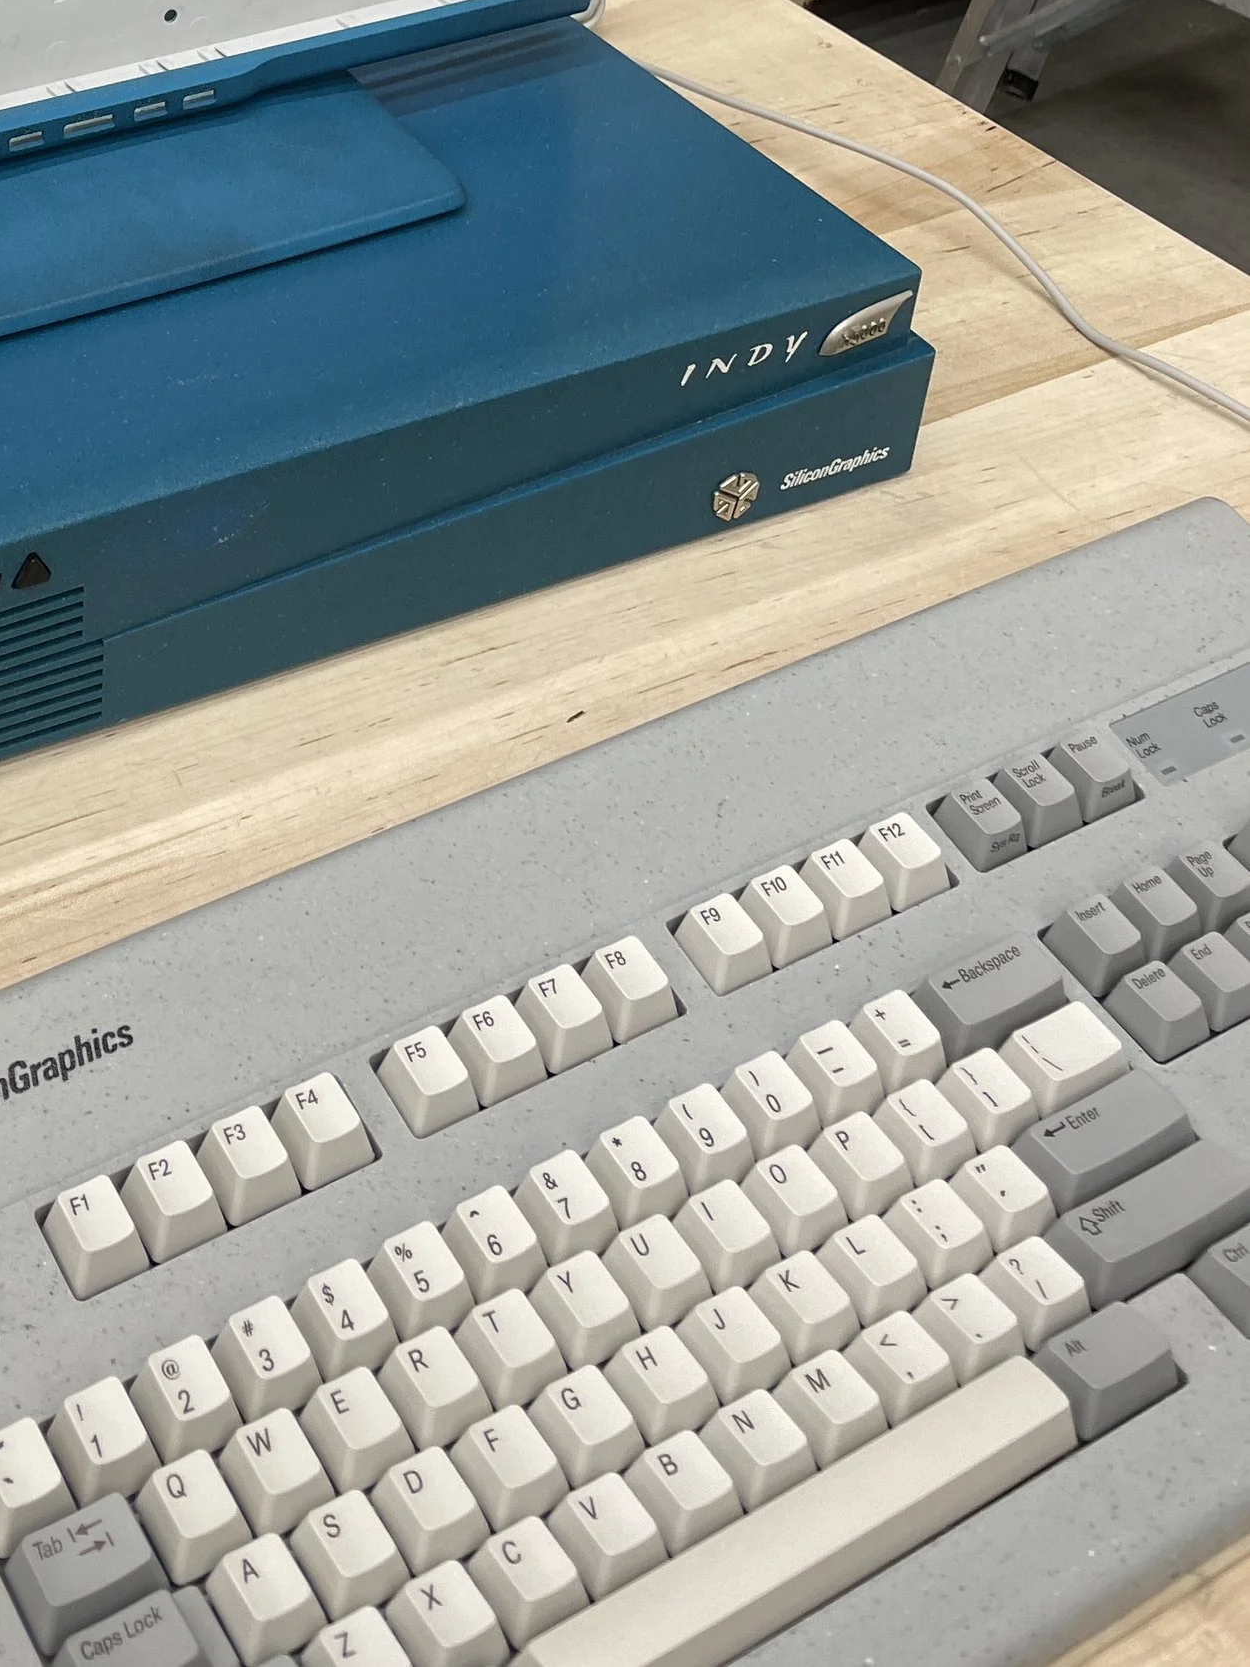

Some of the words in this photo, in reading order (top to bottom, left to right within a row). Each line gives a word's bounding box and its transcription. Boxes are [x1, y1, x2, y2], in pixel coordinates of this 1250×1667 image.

[680, 331, 808, 387] INDY
[780, 446, 890, 491] SiliconGraphics
[1193, 701, 1220, 718] Caps
[1203, 712, 1228, 729] Lock
[1068, 736, 1098, 754] Pause
[1126, 732, 1151, 748] Num
[1135, 742, 1162, 759] Lock
[1012, 760, 1041, 778] Scroll
[1021, 773, 1047, 789] Lock
[959, 789, 982, 806] Print
[969, 796, 1001, 816] Screen
[878, 822, 906, 842] F12
[820, 850, 844, 871] F11
[1186, 850, 1213, 868] Page
[1198, 865, 1215, 879] Up
[760, 875, 788, 897] F10
[1133, 874, 1163, 895] Home
[700, 906, 722, 926] F9
[1074, 901, 1106, 923] Insert
[605, 950, 626, 969] F8
[1190, 943, 1213, 961] End
[957, 944, 1021, 985] Backspace
[538, 979, 558, 998] F7
[1132, 967, 1167, 991] Delete
[473, 1011, 495, 1031] F6
[404, 1041, 427, 1062] F5
[296, 1089, 319, 1110] F4
[765, 1094, 781, 1114] 0
[1066, 1105, 1101, 1130] Enter
[223, 1123, 246, 1144] F3
[699, 1127, 714, 1147] 9
[836, 1130, 850, 1151] P
[148, 1158, 172, 1181] F2
[631, 1161, 647, 1182] 8
[543, 1172, 559, 1190] &
[69, 1194, 90, 1216] F1
[557, 1197, 573, 1219] 7
[1092, 1198, 1126, 1225] Shift
[395, 1242, 413, 1262] %
[486, 1233, 503, 1256] 6
[631, 1235, 650, 1257] U
[844, 1236, 866, 1255] L
[1223, 1242, 1250, 1262] Ctrl
[413, 1270, 430, 1293] 5
[557, 1271, 575, 1293] Y
[778, 1270, 801, 1293] K
[321, 1284, 336, 1305] $
[241, 1319, 255, 1337] #
[339, 1308, 355, 1330] 4
[482, 1309, 503, 1333] T
[713, 1309, 727, 1331] J
[407, 1348, 429, 1372] R
[635, 1347, 658, 1371] H
[1065, 1340, 1086, 1358] Alt
[161, 1359, 180, 1380] @
[259, 1349, 274, 1372] 3
[804, 1367, 831, 1394] M
[178, 1390, 194, 1415] 2
[330, 1390, 350, 1415] E
[561, 1387, 582, 1411] G
[731, 1410, 756, 1434] N
[91, 1434, 102, 1458] 1
[246, 1429, 272, 1457] W
[483, 1429, 502, 1452] F
[658, 1453, 679, 1476] B
[166, 1474, 187, 1499] Q
[403, 1470, 423, 1494] D
[579, 1495, 599, 1520] V
[323, 1514, 342, 1538] S
[32, 1536, 63, 1561] Tab
[502, 1540, 522, 1565] C
[242, 1558, 259, 1583] A
[420, 1584, 443, 1611] X
[80, 1626, 123, 1661] Caps
[123, 1604, 163, 1639] Lock
[335, 1632, 356, 1659] Z
